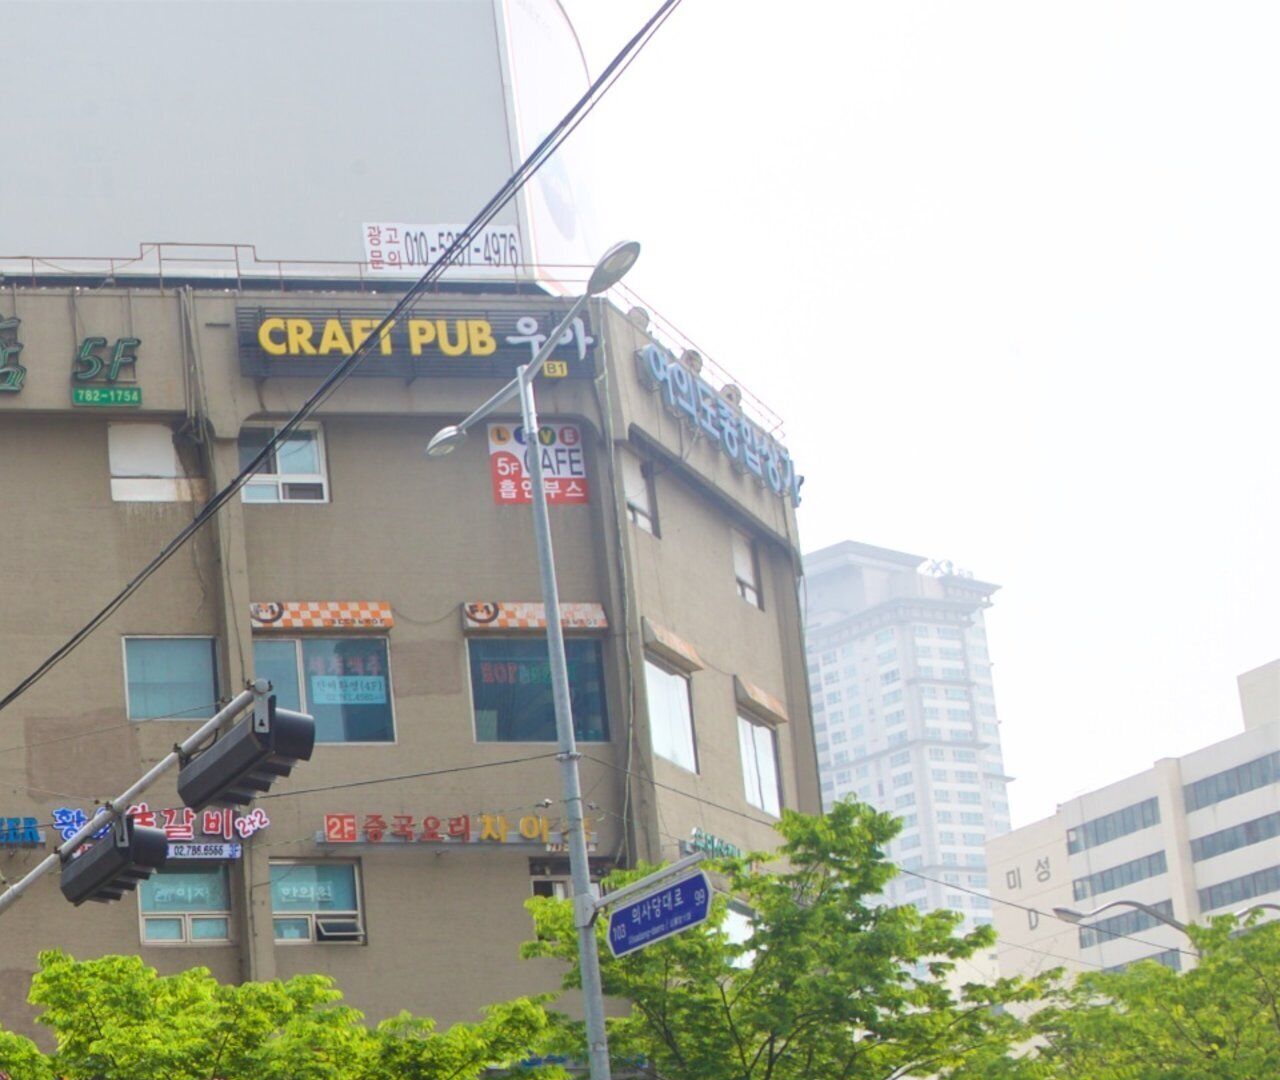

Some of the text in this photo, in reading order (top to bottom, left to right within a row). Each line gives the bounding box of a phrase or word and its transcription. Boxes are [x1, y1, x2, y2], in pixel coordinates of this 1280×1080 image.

[258, 318, 396, 356] CRAFT
[408, 318, 497, 356] PUB
[73, 337, 141, 382] 5F
[545, 362, 567, 375] B1
[495, 426, 580, 445] LVE
[497, 457, 519, 476] 5F
[236, 808, 269, 838] 2+2
[327, 817, 356, 840] 2F
[363, 815, 472, 842] 중국요리
[1005, 856, 1052, 890] 미성
[631, 887, 685, 924] 의사당대로
